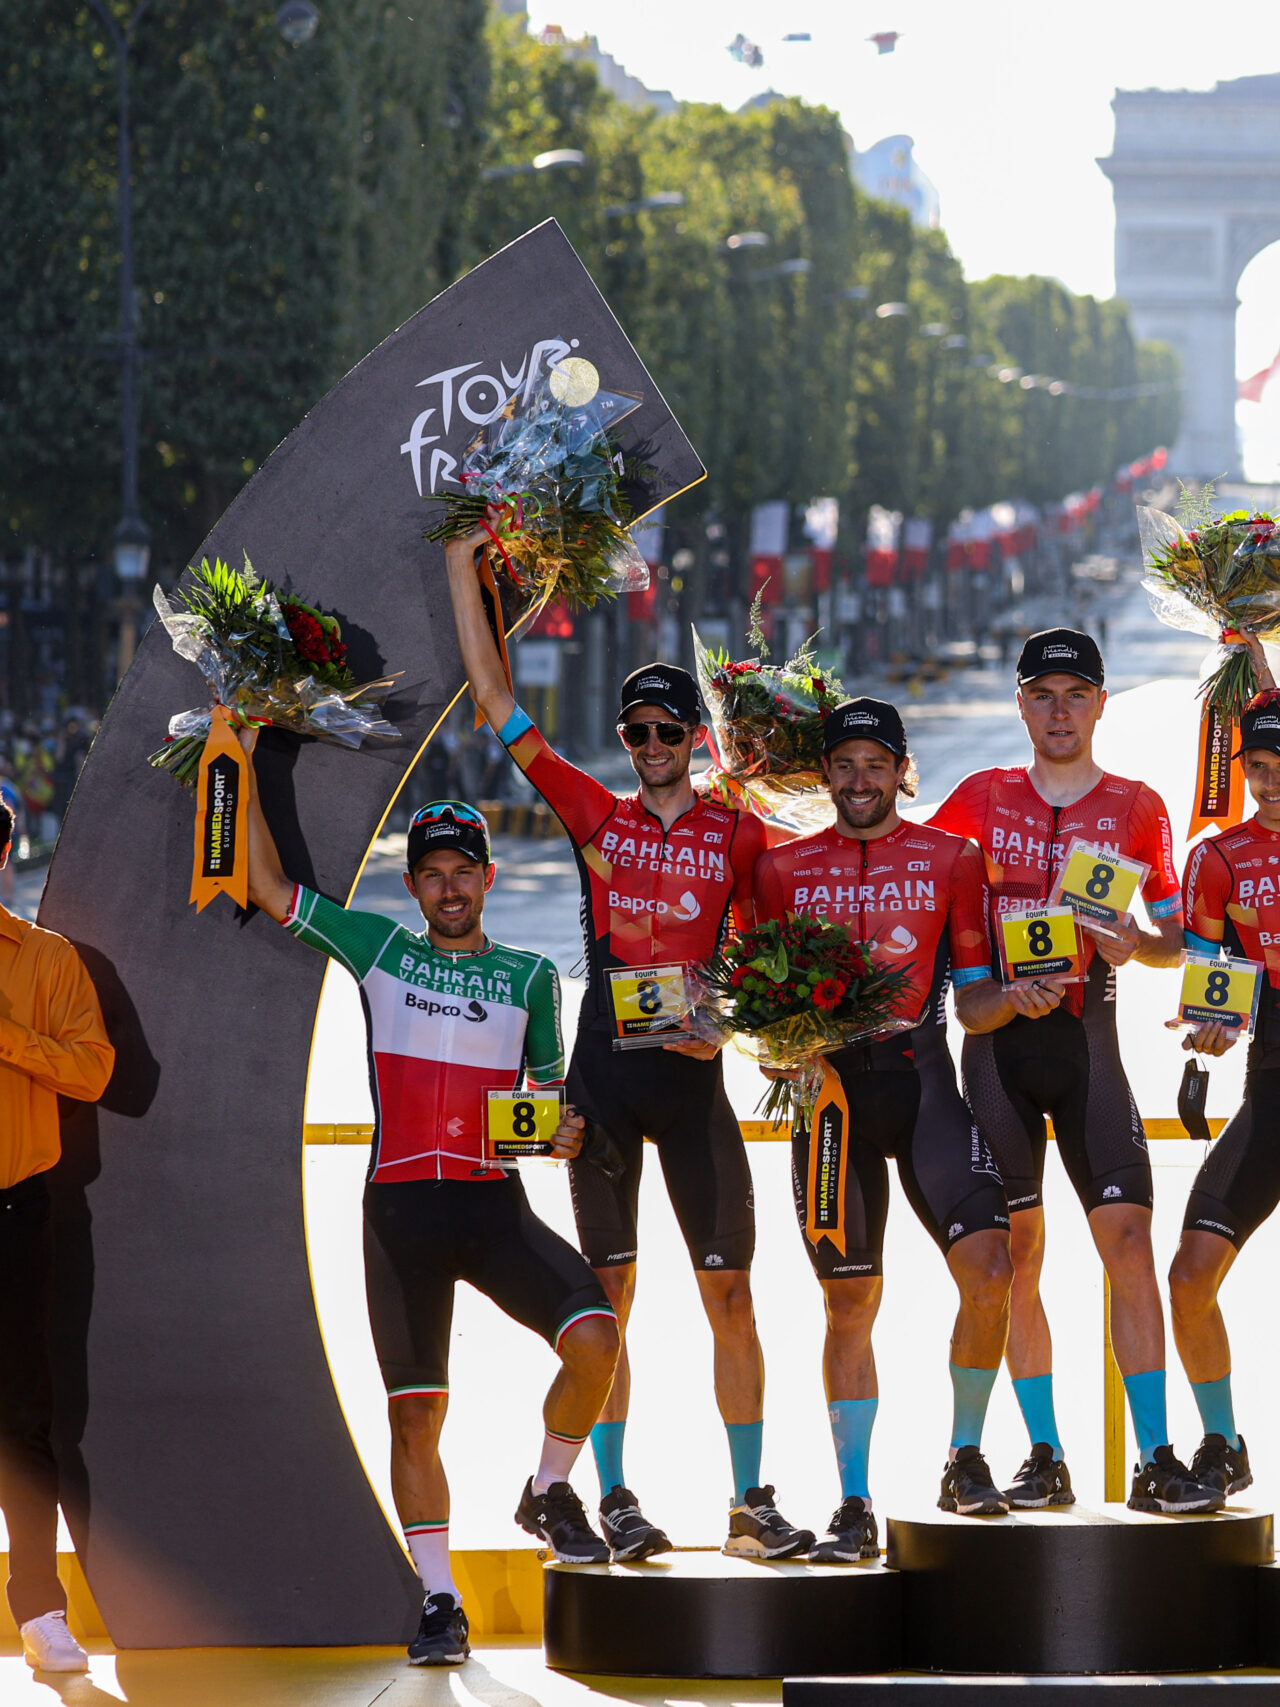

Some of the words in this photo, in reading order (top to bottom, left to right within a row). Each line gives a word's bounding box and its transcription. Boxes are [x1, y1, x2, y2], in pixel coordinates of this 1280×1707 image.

[415, 339, 579, 436] TOUR
[1219, 732, 1229, 789] SUPERFOOD
[223, 793, 234, 848] SUPERFOOD
[601, 831, 725, 870] BAHRAIN
[1098, 851, 1120, 866] ÉQUIPE
[1158, 816, 1176, 884] MERIDA
[600, 850, 725, 882] VICTORIOUS
[793, 868, 811, 877] NBB
[1235, 860, 1252, 869] NBB
[794, 880, 936, 905] BAHRAIN
[1085, 863, 1114, 900] 8
[1186, 843, 1208, 926] MERIDA
[608, 890, 669, 914] Bapco
[794, 899, 936, 918] VICTORIOUS
[997, 895, 1054, 913] Bapc
[1025, 910, 1048, 919] ÉQUIPE
[1028, 920, 1053, 957] 8
[400, 953, 513, 996] BAHRAIN
[634, 970, 658, 979] ÉQUIPE
[1023, 960, 1065, 969] NAMEDSPORT
[1209, 959, 1232, 970] ÉQUIPE
[398, 969, 513, 1005] VICTORIOUS
[637, 980, 663, 1015] 8
[1204, 970, 1230, 1007] 8
[405, 992, 461, 1017] Bapco
[1193, 1009, 1235, 1021] NAMEDSPORT
[512, 1091, 535, 1100] ÉQUIPE
[512, 1101, 536, 1138] 8
[971, 1125, 979, 1162] BUSINESS
[829, 1142, 838, 1200] SUPERFOOD
[1196, 1218, 1235, 1237] MERIDA
[607, 1250, 637, 1261] MERID
[833, 1264, 873, 1273] MERIDA
